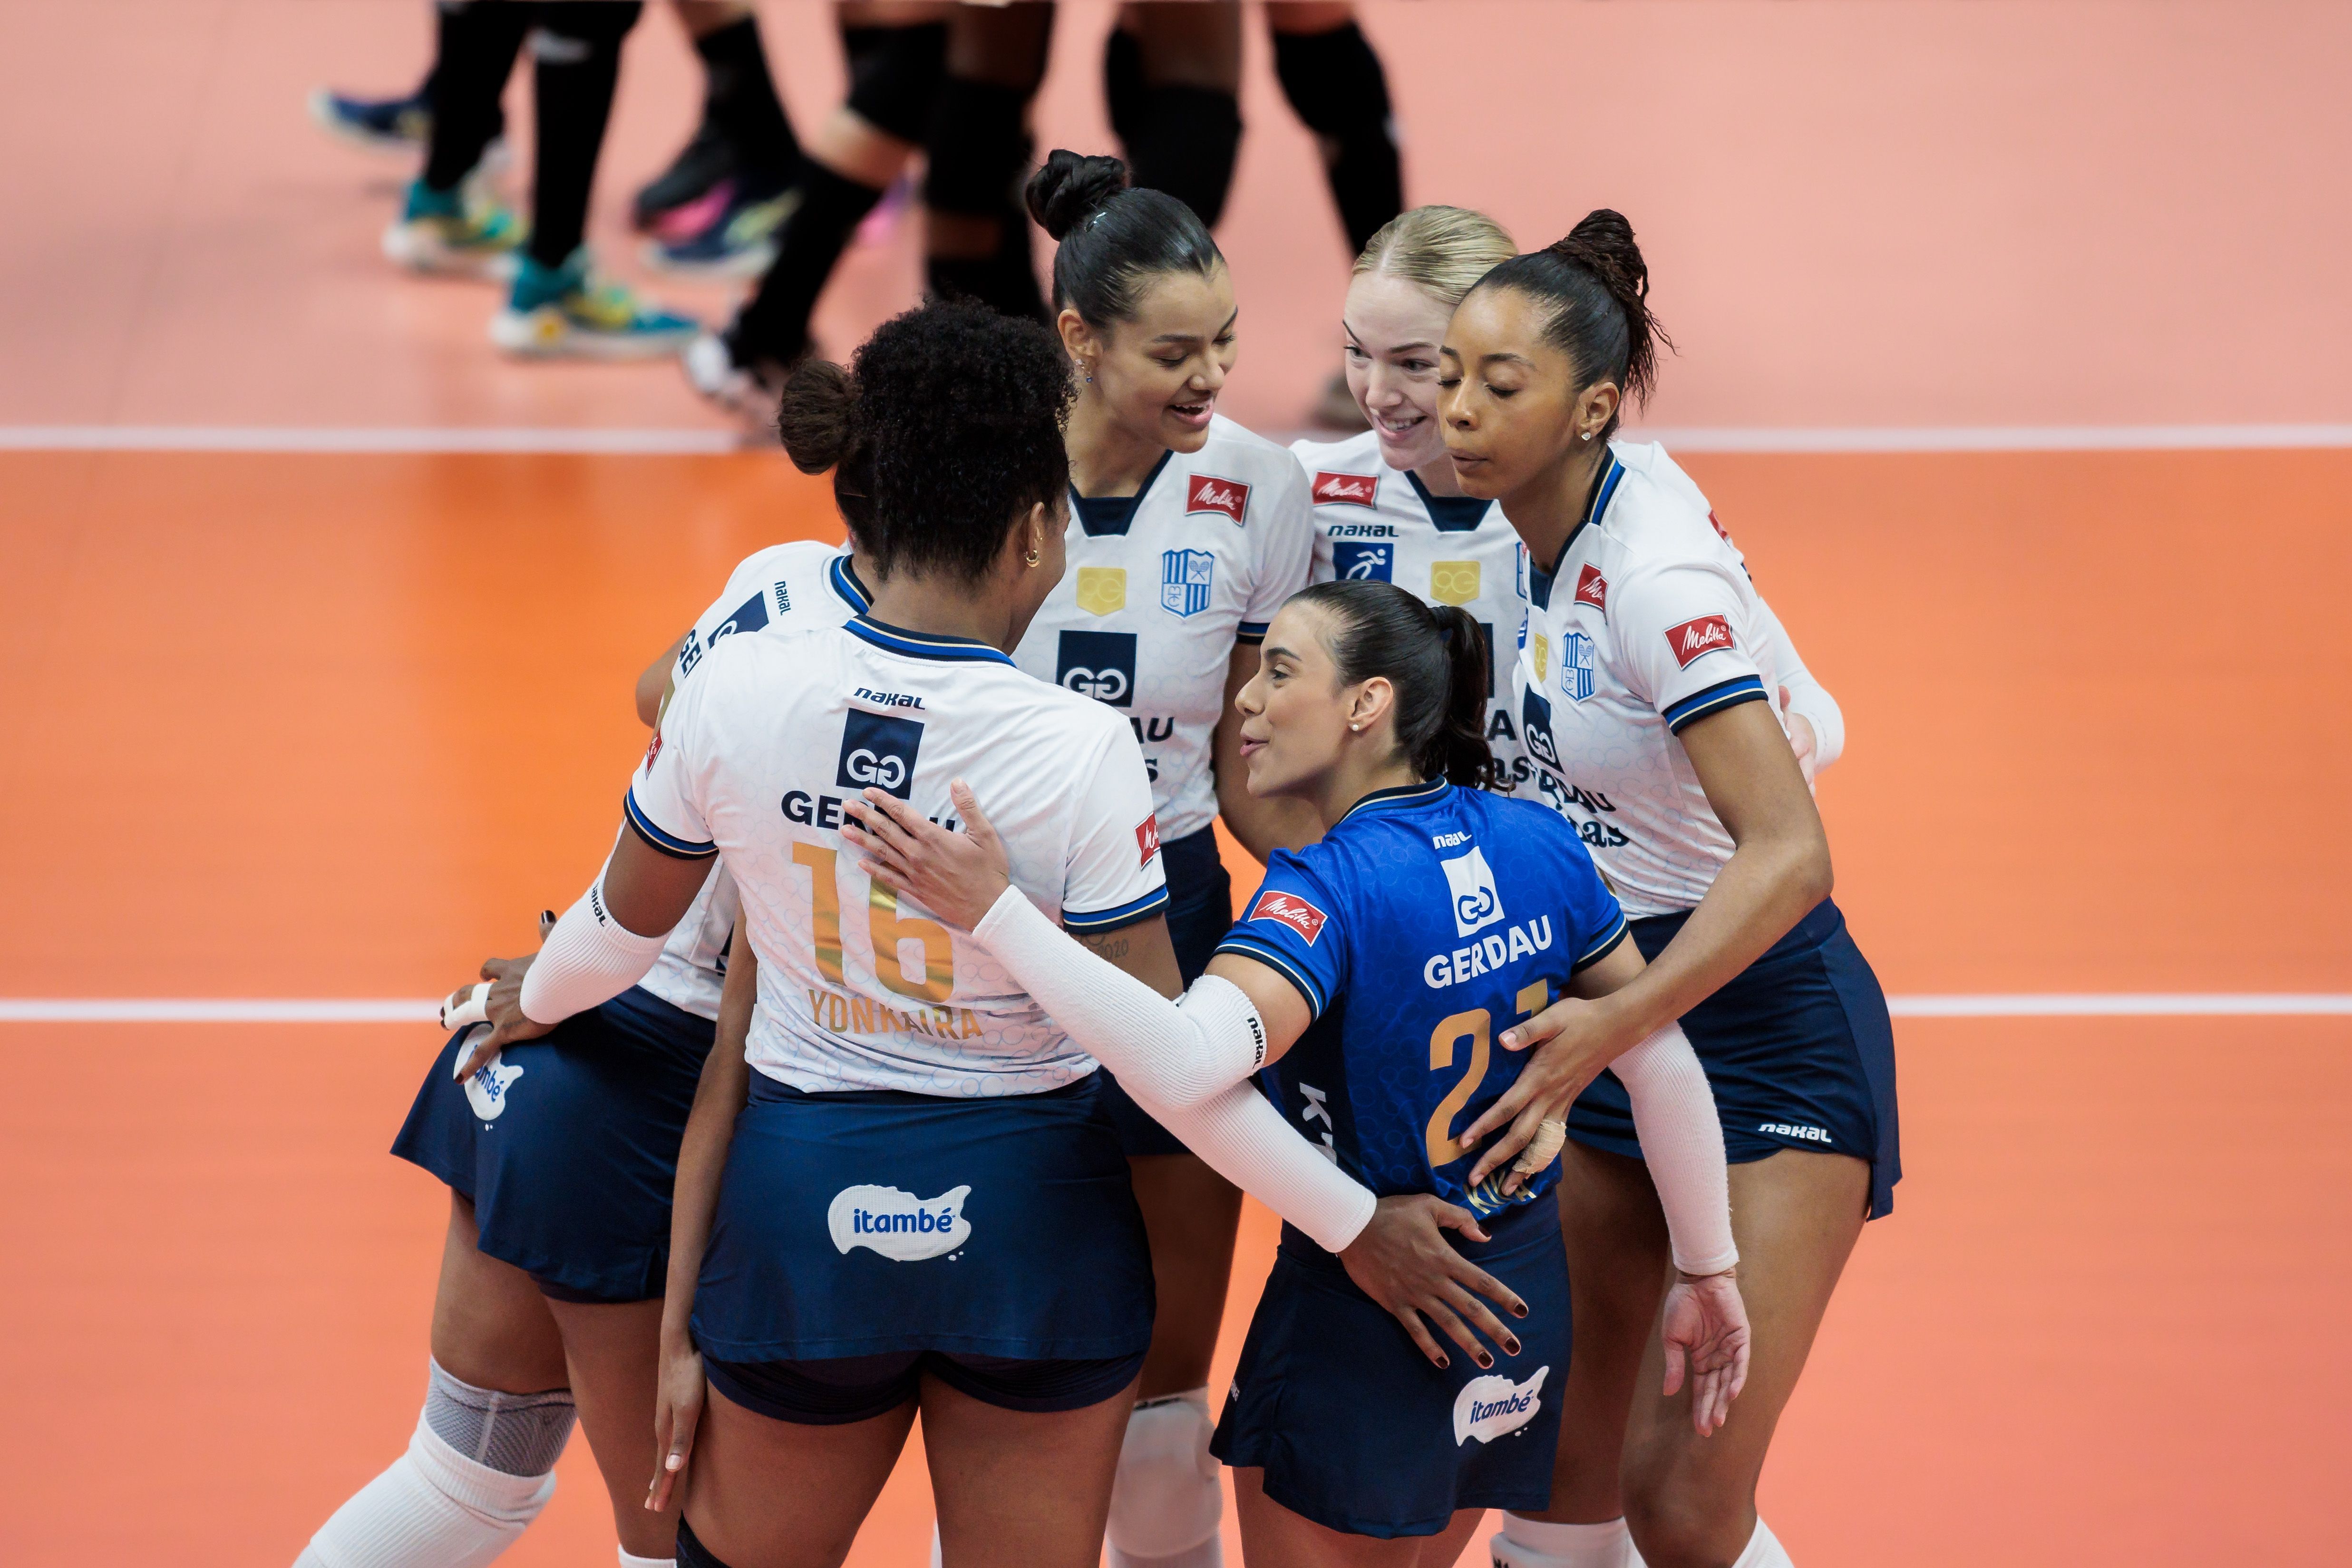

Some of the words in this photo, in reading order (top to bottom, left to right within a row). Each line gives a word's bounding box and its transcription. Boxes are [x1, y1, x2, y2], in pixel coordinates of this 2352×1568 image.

[1681, 623, 1727, 656] Melitta
[792, 841, 954, 1003] 16
[1258, 897, 1311, 929] Melitta
[1424, 915, 1552, 989] GERDAU
[808, 988, 983, 1040] YONKAIRA
[854, 1207, 952, 1233] itambé
[1469, 1389, 1534, 1425] itambé
